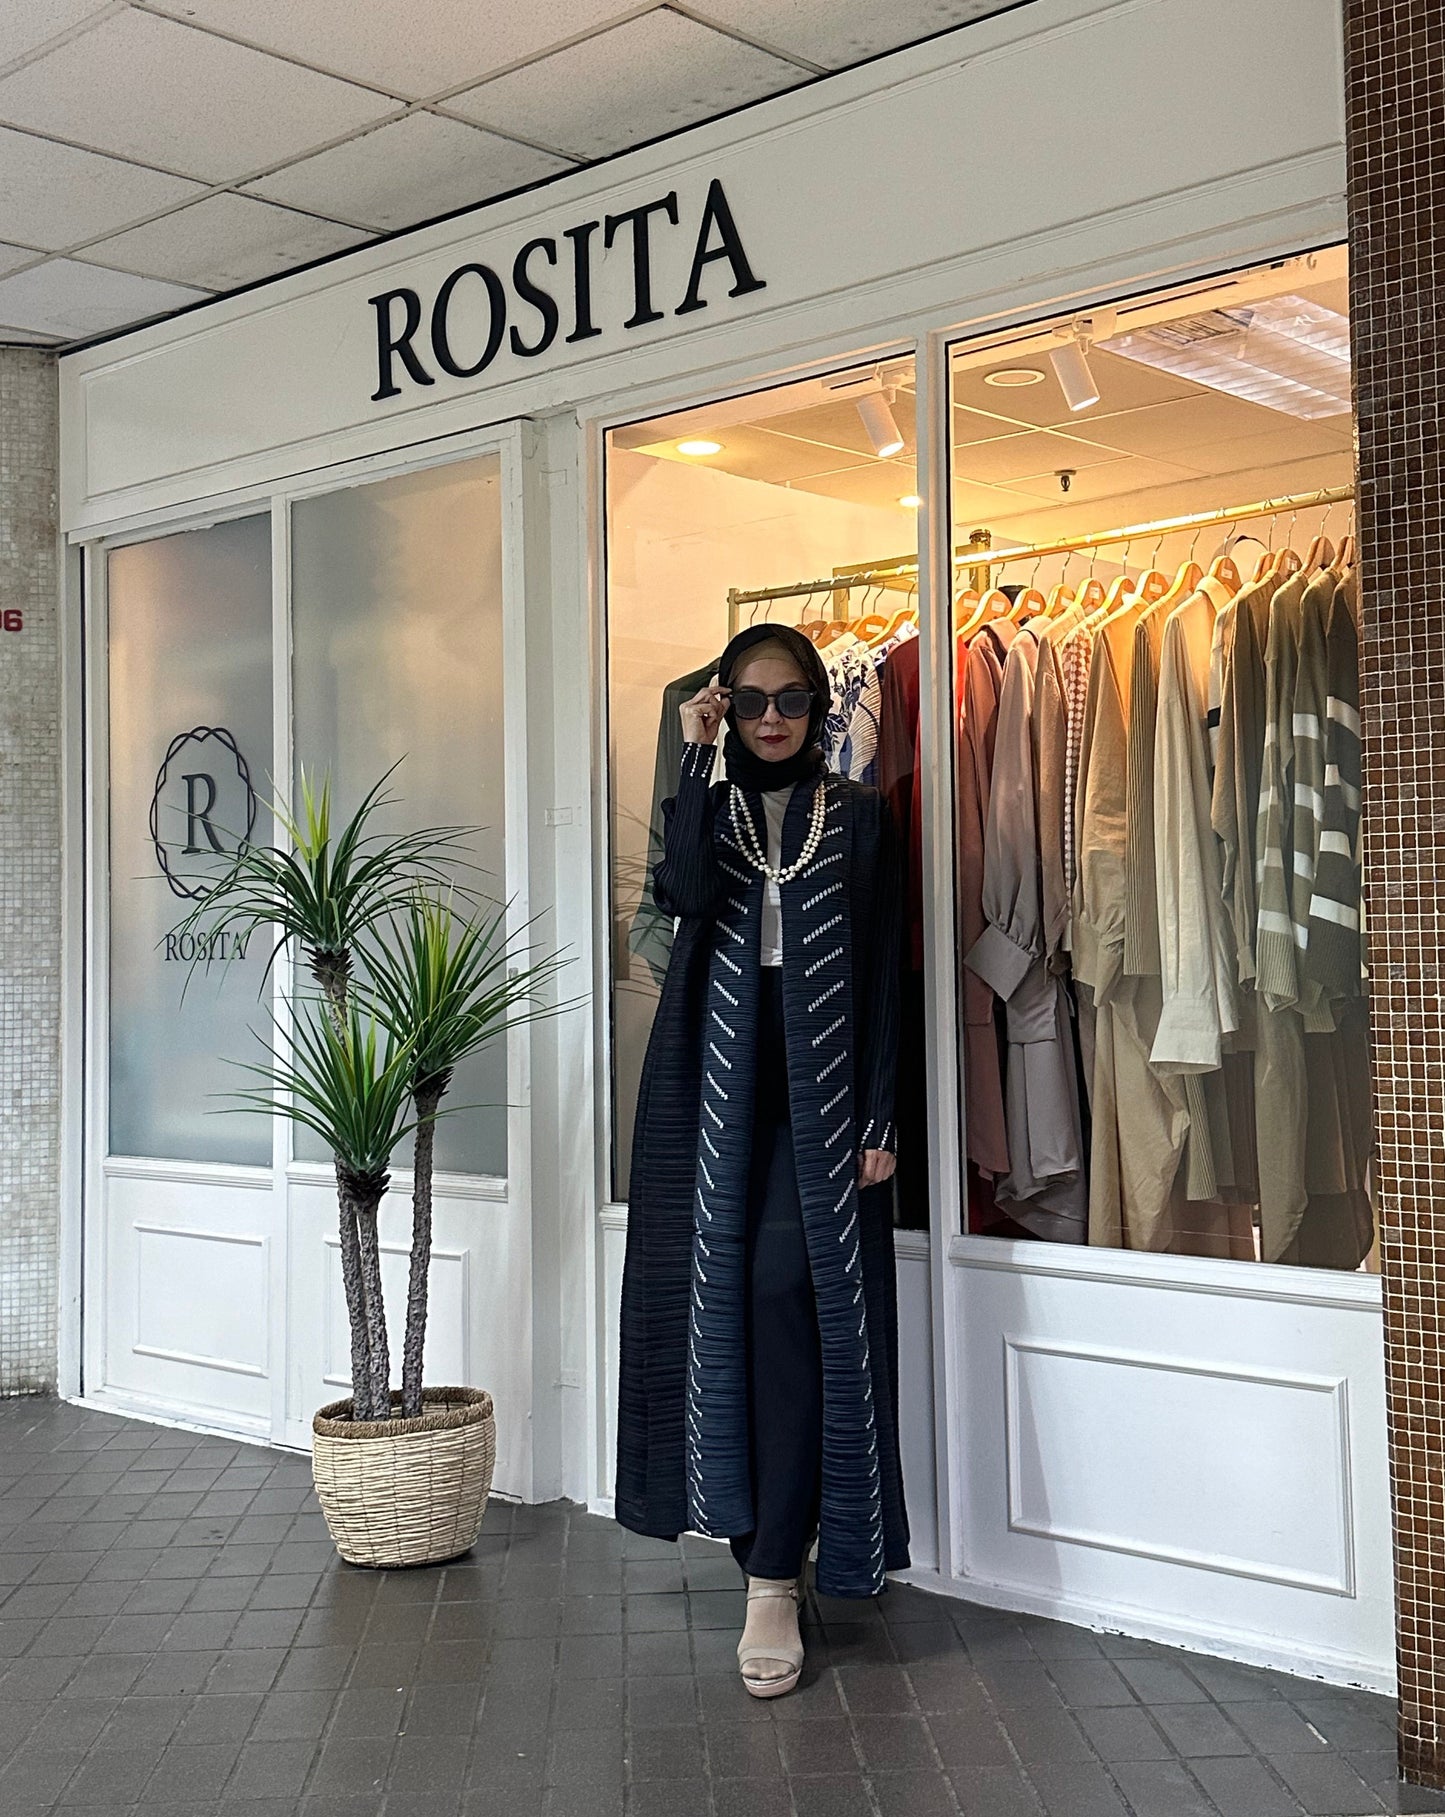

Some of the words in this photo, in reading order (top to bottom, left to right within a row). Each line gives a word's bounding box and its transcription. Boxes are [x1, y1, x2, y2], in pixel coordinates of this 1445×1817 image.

[368, 178, 767, 401] ROSITA
[0, 608, 23, 632] 6
[181, 773, 225, 855] R
[165, 931, 246, 961] ROSITA
